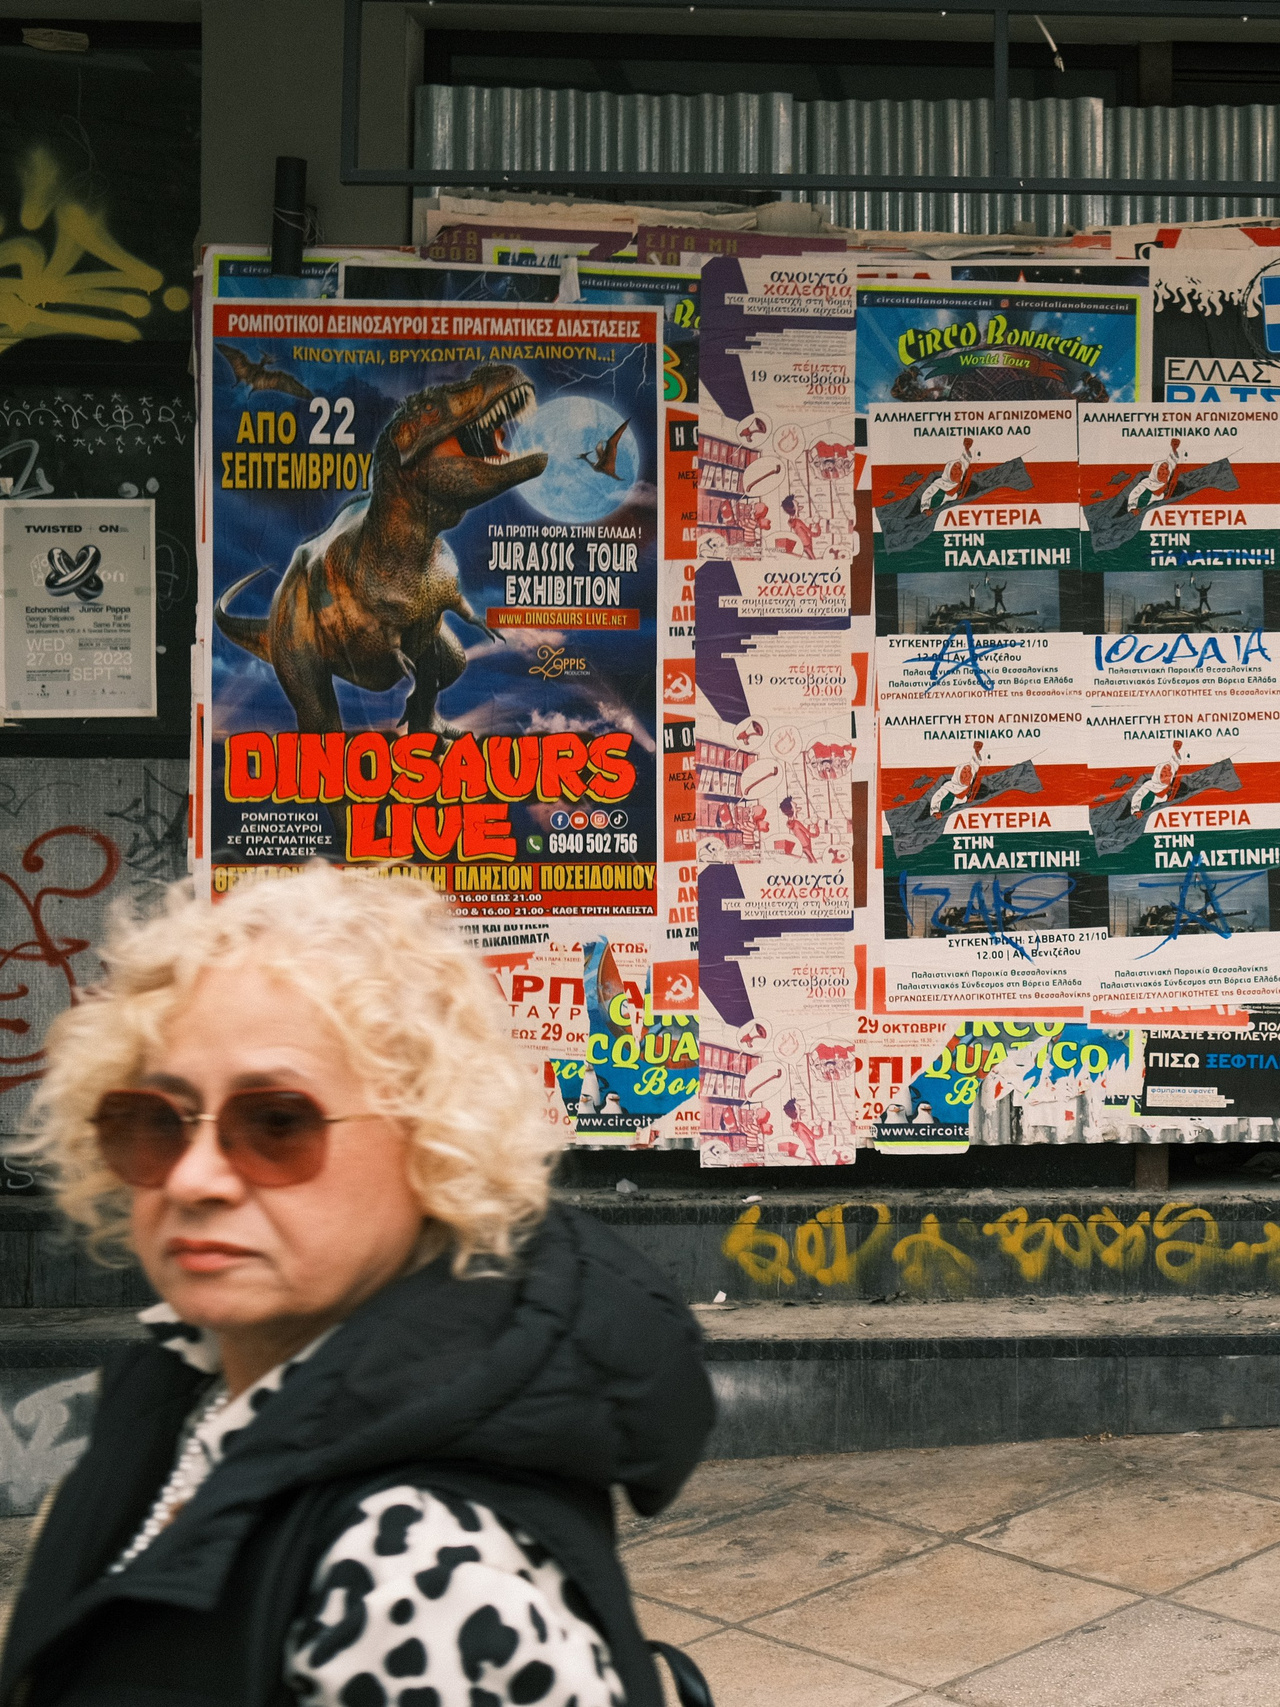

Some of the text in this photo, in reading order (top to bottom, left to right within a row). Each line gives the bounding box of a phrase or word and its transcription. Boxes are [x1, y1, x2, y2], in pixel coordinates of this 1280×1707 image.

[770, 268, 847, 289] ανοιχτό
[764, 279, 853, 299] κάλεσμα
[726, 295, 744, 305] για
[747, 295, 802, 307] συμμετοχή
[805, 296, 823, 307] στη
[746, 304, 853, 317] κινηματικού αρχείου
[228, 314, 641, 338] ΡΟΜΠΟΤΙΚΟΙ ΔΕΙΝΟΣΑΥΡΟΙ ΣΕ ΠΡΑΓΜΑΤΙΚΕΣ ΔΙΑΣΤΑΣΕΙΣ
[293, 346, 616, 365] ΚΙΝΟΥΝΤΑΙ, ΒΡΥΧΩΝΤΑΙ, ΑΝΑΣΑΙΝΟΥΝ...!
[959, 353, 1031, 368] World Tour
[793, 360, 847, 376] πέμπτη
[1167, 358, 1270, 383] ΕΛΛΑΣ
[751, 370, 850, 386] 19 οκτωβρίου
[806, 384, 847, 396] 20:00
[236, 397, 355, 445] ΑΠΟ 22
[221, 452, 372, 490] ΣΕΠΤΕΜΒΡΙΟΥ
[943, 509, 1042, 527] ΛΕΥΤΕΡΙΑ
[25, 525, 119, 533] TWISTED ON
[488, 525, 636, 539] ΓΙΑ ΠΡΩΤΗ ΦΟΡΑ ΣΤΗΝ ΕΛΛΑΔΑ
[943, 533, 984, 547] ΣΤΗΝ
[489, 541, 638, 572] JURASSIC TOUR
[945, 549, 1070, 567] ΠΑΛΑΙΣΤΙΝΗ!
[505, 575, 620, 606] EXHIBITION
[25, 605, 131, 615] Echonomist Junior Pappa
[26, 638, 65, 652] WED
[93, 651, 132, 666] 2023
[72, 667, 114, 680] SEPT
[885, 712, 1083, 726] ΑΛΛΗΛΕΓΓΥΗ ΣΤΟΝ ΑΓΩΝΙΖΟΜΕΝΟ
[924, 728, 1041, 740] ΠΑΛΑΙΣΤΙΝΙΑΚΟ ΛΑΟ
[225, 731, 638, 804] DINOSAURS
[241, 813, 318, 822] ΡΟΜΠΟΤΙΚΟΙ
[953, 811, 1052, 830] ΛΕΥΤΕΡΙΑ
[240, 824, 322, 833] ΔΕΙΝΟΣΑΥΡΟΙ
[345, 802, 518, 862] LIVE
[227, 836, 332, 845] ΣΕ ΠΡΑΓΜΑΤΙΚΕΣ
[549, 833, 638, 854] 6940 502 756
[953, 836, 994, 850] ΣΤΗΝ
[246, 847, 317, 856] ΔΙΑΣΤΑΣΕΙΣ
[954, 851, 1080, 870] ΠΑΛΑΙΣΤΙΝΗ!
[454, 865, 533, 891] ΠΛΗΣΙΟΝ
[540, 865, 656, 891] ΠΟΣΕΙΔΟΝΙΟΥ
[459, 894, 542, 902] 16.00 ΕΩΣ 21.00
[481, 906, 654, 916] 16.00 21.00 ΚΑΘΕ ΤΡΙΤΗ ΚΛΕΙΣΤΑ
